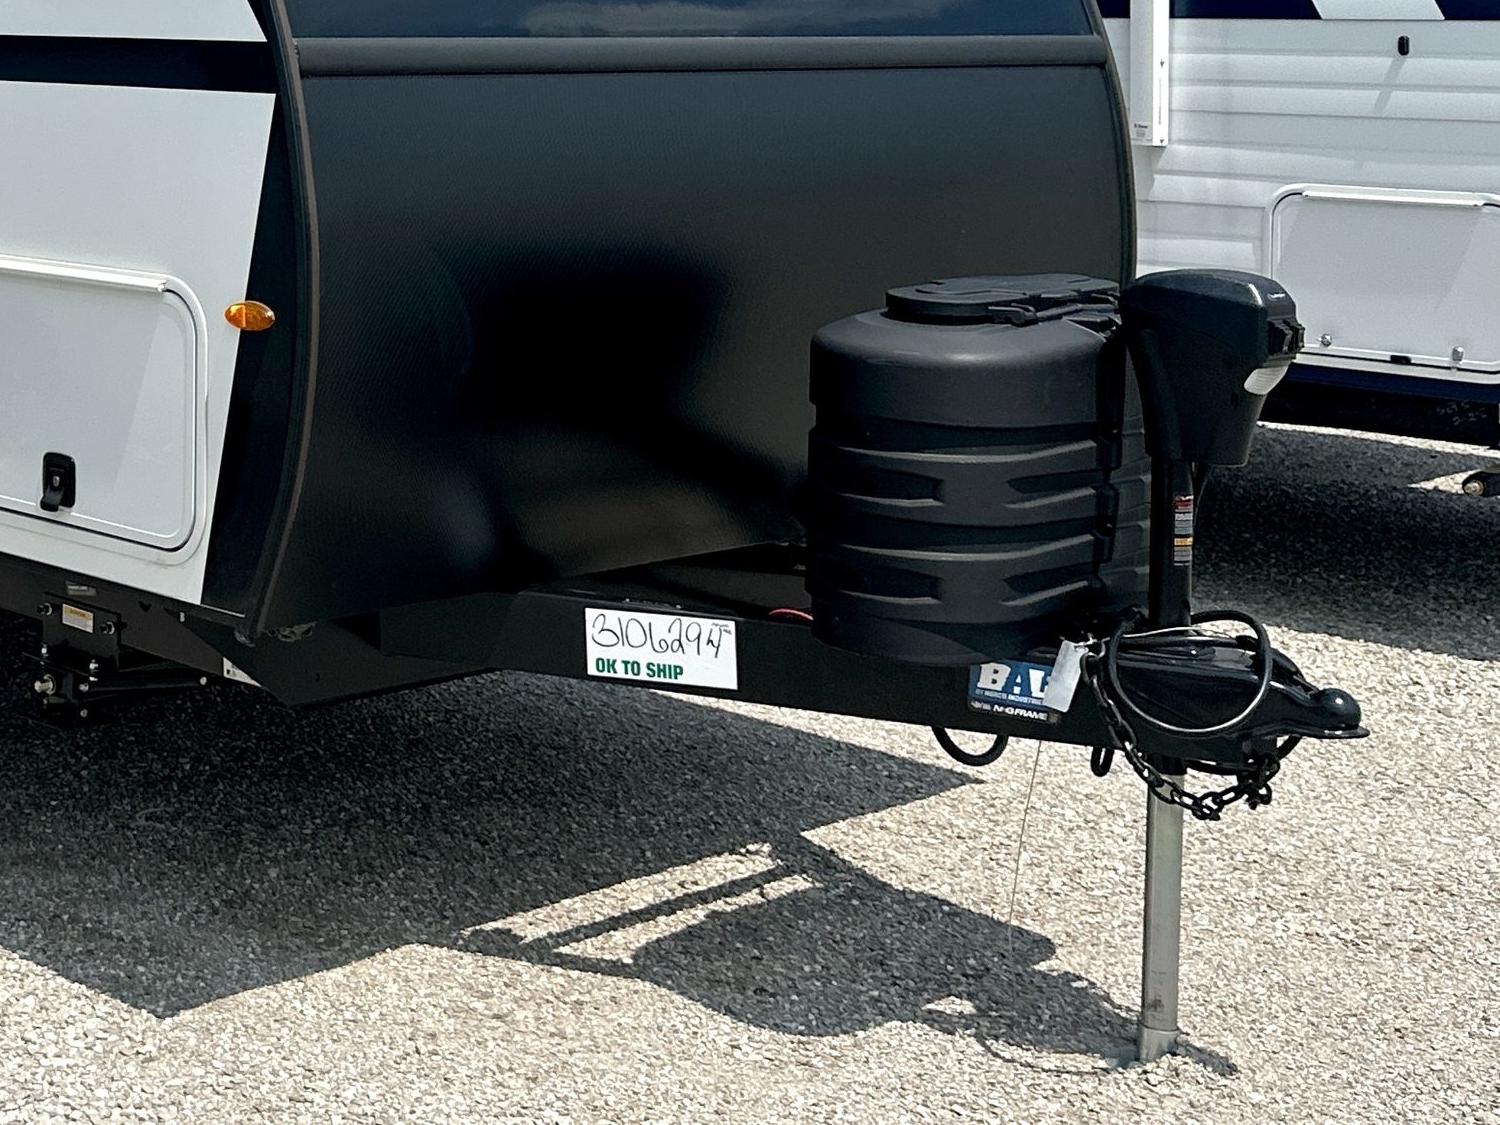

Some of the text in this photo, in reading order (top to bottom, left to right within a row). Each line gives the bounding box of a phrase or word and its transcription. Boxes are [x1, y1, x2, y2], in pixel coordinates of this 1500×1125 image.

[591, 613, 723, 659] 3106294
[595, 657, 684, 681] OK TO SHIP
